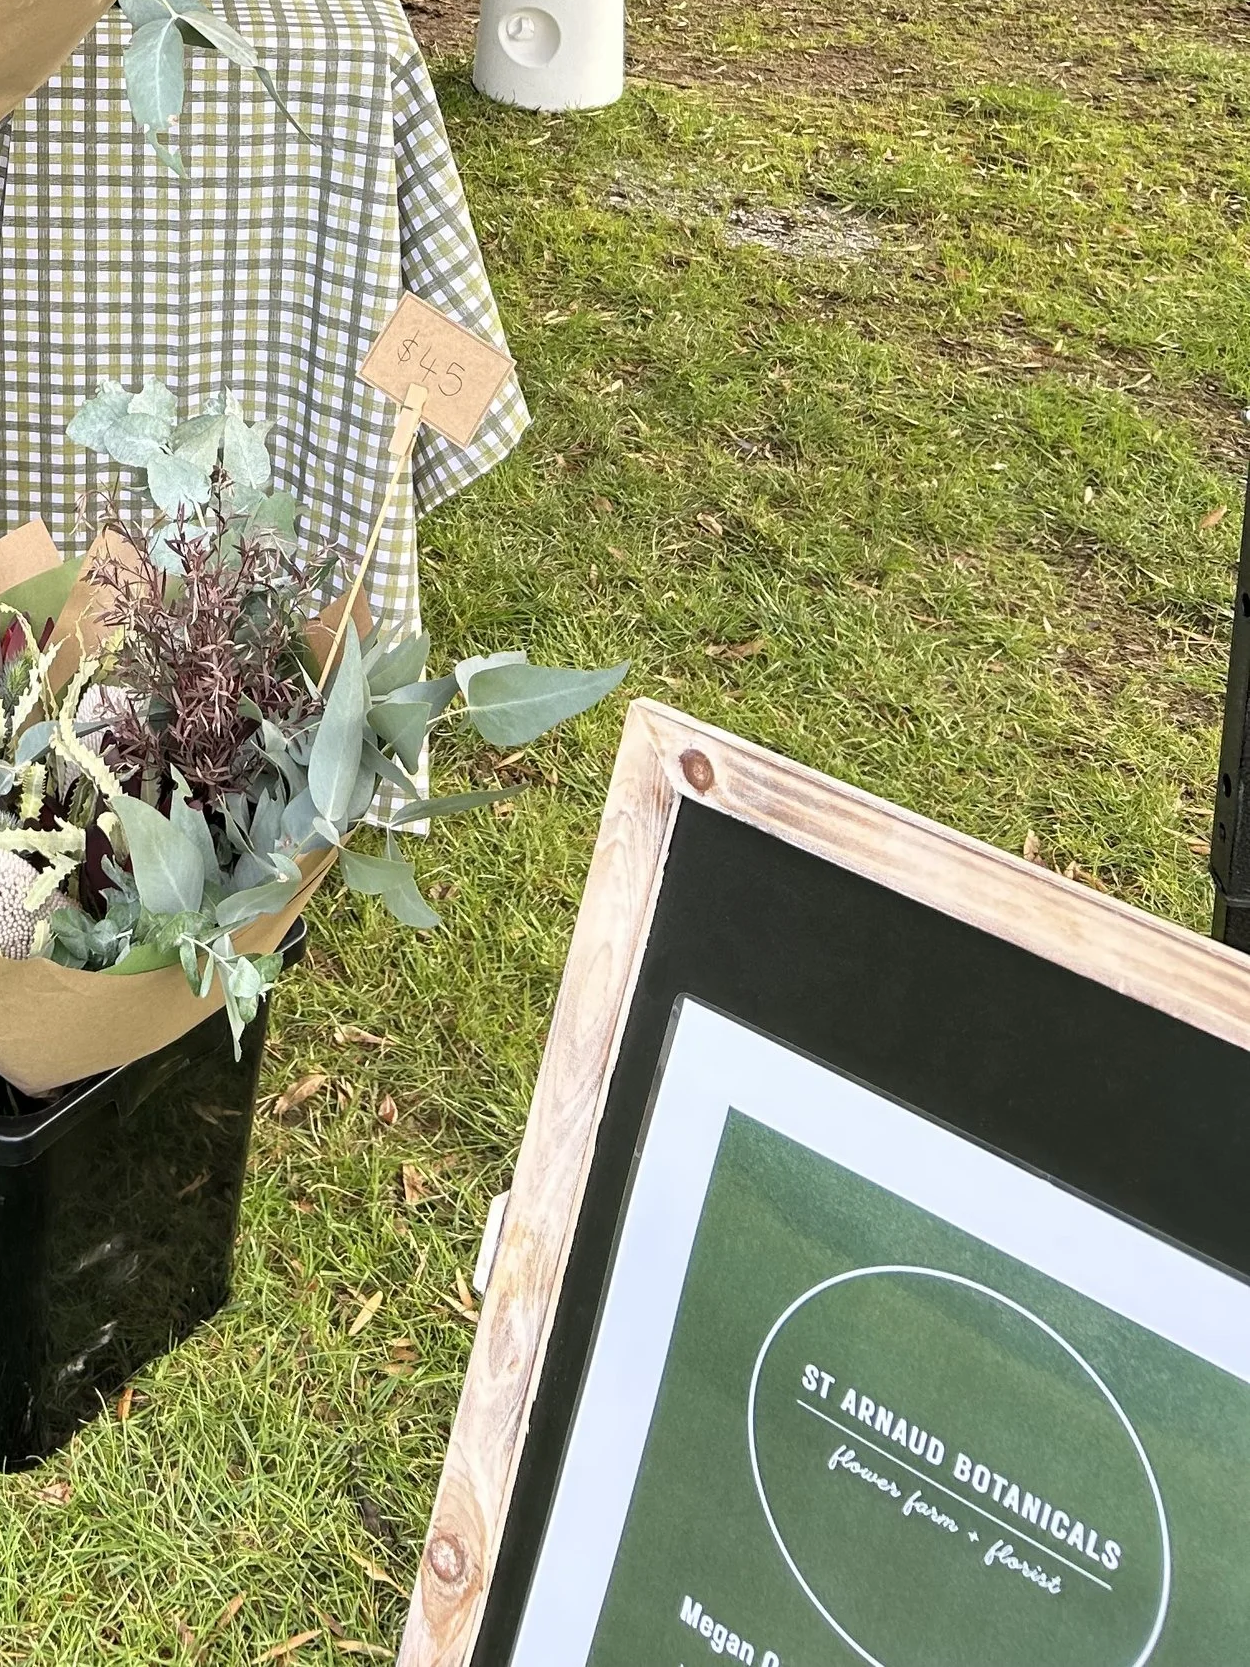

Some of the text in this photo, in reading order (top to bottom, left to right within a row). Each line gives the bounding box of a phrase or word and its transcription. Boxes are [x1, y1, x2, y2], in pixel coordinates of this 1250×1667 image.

[398, 330, 465, 397] $45
[801, 1364, 1122, 1571] ST ARNAUD BOTANICALS
[827, 1444, 1062, 1594] flower farm + florist
[679, 1595, 755, 1667] Megan
